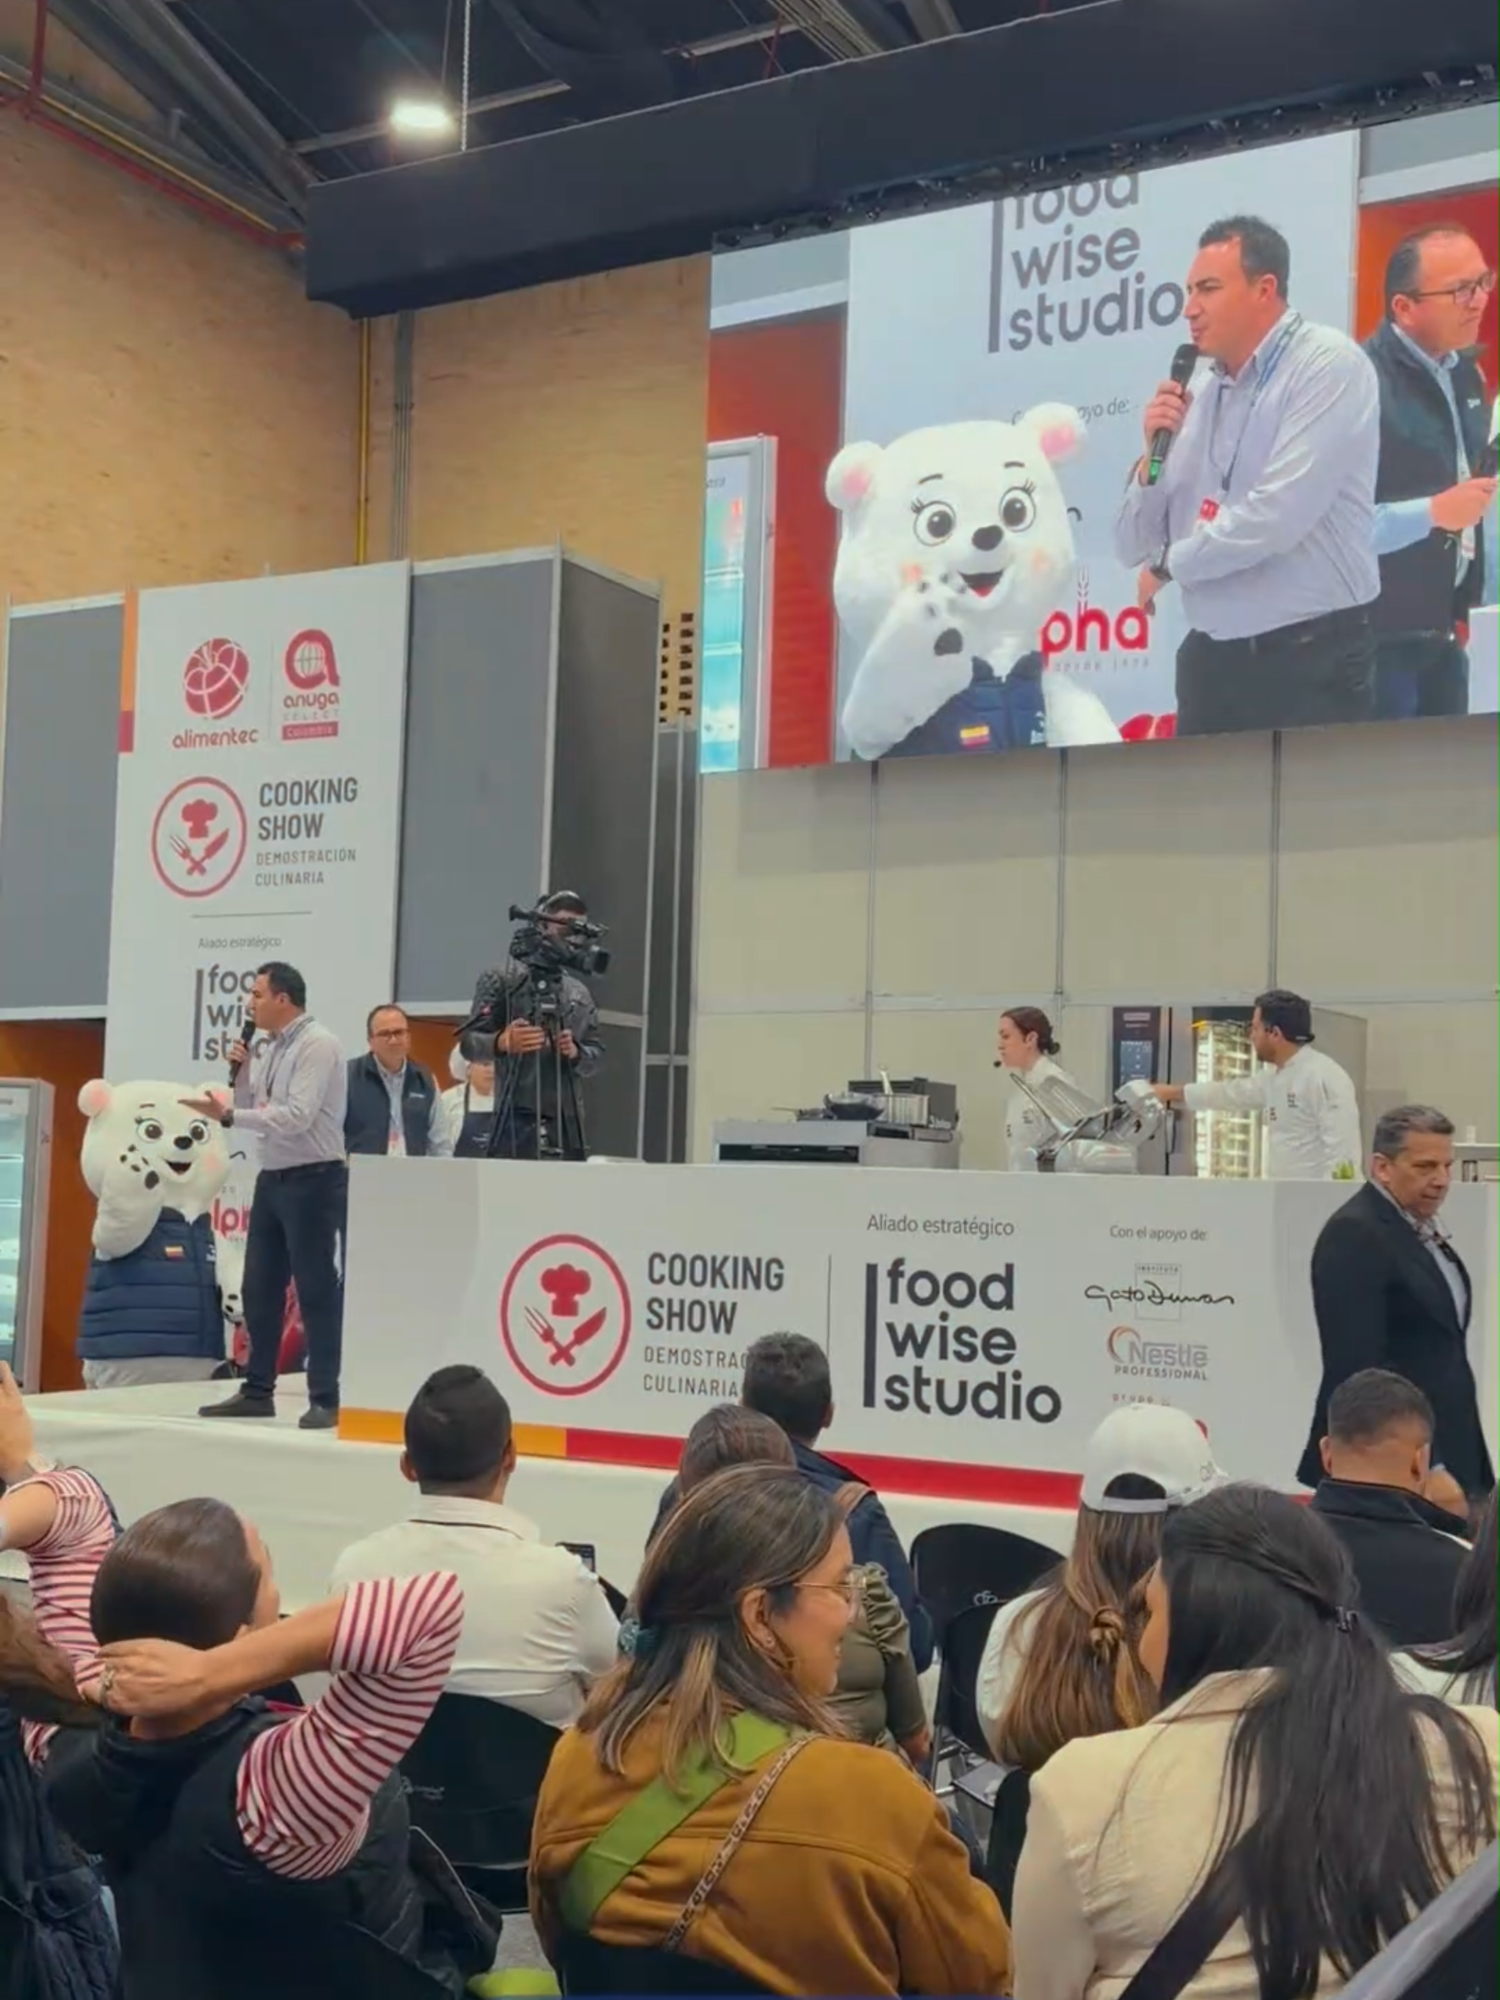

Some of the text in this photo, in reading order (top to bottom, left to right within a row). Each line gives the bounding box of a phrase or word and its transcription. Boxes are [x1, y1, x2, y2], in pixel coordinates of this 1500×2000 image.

[1011, 223, 1141, 290] wise
[1008, 271, 1185, 351] studio
[283, 692, 340, 711] anuga
[172, 727, 259, 749] alimentec
[259, 777, 358, 808] COOKING
[258, 813, 324, 841] SHOW
[255, 871, 324, 887] CULINARIA
[208, 963, 257, 994] foo
[867, 1214, 1015, 1241] Aliado estratégico
[1110, 1225, 1134, 1239] Con
[1136, 1226, 1147, 1239] el
[1149, 1228, 1187, 1243] apoyo
[648, 1252, 784, 1291] COOKING
[887, 1257, 1015, 1311] food
[646, 1297, 738, 1335] SHOW
[885, 1310, 1017, 1366] wise
[643, 1345, 749, 1370] DEMOSTRAC
[643, 1373, 739, 1398] CULINARIA
[1114, 1365, 1208, 1381] PROFESSIONAL
[884, 1365, 1062, 1424] studio
